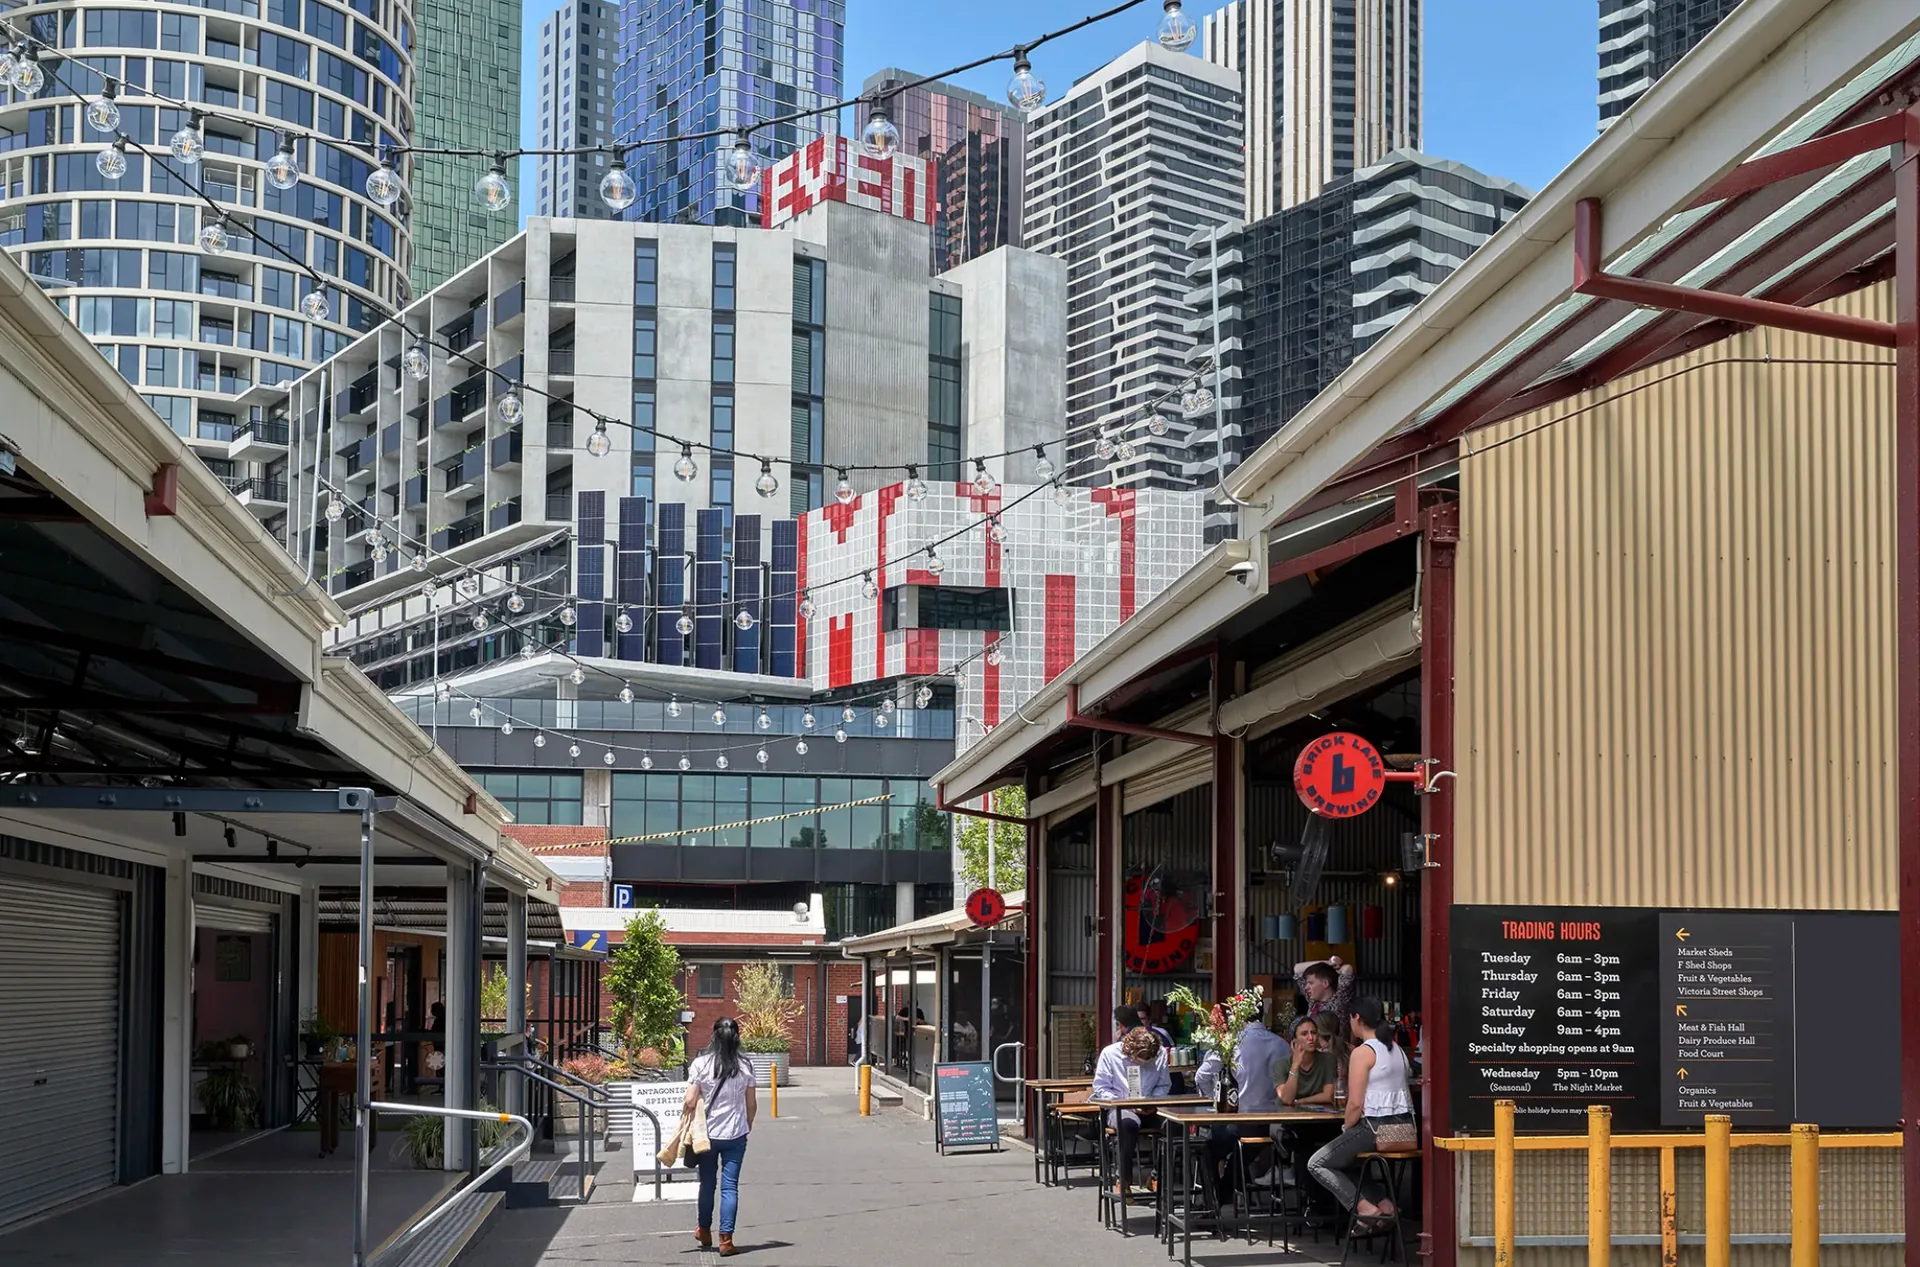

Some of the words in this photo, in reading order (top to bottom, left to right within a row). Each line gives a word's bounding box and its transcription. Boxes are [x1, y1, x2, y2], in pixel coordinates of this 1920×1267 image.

[1303, 736, 1345, 775] BRICK
[1352, 738, 1381, 779] LANE
[1332, 753, 1355, 794] b
[1306, 785, 1378, 814] BREWING
[619, 888, 630, 908] P
[1502, 921, 1554, 939] TRADING
[1561, 922, 1600, 940] HOURS
[1678, 948, 1707, 956] Market
[1482, 952, 1531, 965] Tuesday
[1557, 953, 1582, 964] 6am
[1594, 953, 1620, 966] 3pm
[1678, 961, 1684, 969] F
[1707, 962, 1732, 971] Shops
[1482, 970, 1538, 983] Thursday
[1557, 971, 1582, 982] 6am
[1594, 971, 1620, 983] 3pm
[1678, 974, 1697, 982] Fruit
[1708, 975, 1751, 984] Vegetables
[1482, 988, 1520, 1001] Friday
[1557, 989, 1582, 999] 6am
[1594, 989, 1620, 1001] 3pm
[1678, 987, 1710, 995] Victoria
[1739, 988, 1763, 997] Shops
[1482, 1006, 1535, 1019] Saturday
[1557, 1006, 1583, 1017] 6am
[1594, 1007, 1620, 1019] 4pm
[1482, 1024, 1525, 1037] Sunday
[1557, 1025, 1583, 1035] 9am
[1594, 1025, 1620, 1037] 4pm
[1679, 1036, 1701, 1046] Dairy
[1469, 1043, 1516, 1054] Specialty
[1519, 1043, 1565, 1054] shopping
[1568, 1045, 1597, 1054] opens
[1612, 1044, 1634, 1052] 9am
[1481, 1068, 1540, 1080] Wednesday
[1557, 1069, 1579, 1079] 5pm
[1590, 1069, 1618, 1079] 10pm
[637, 1087, 688, 1095] ANTAGONIS
[1490, 1083, 1531, 1092] (Seasonal)
[1553, 1083, 1568, 1091] The
[1570, 1084, 1592, 1092] Night
[1679, 1087, 1716, 1095] Organics
[1709, 1099, 1753, 1109] Vegetables
[1528, 1107, 1550, 1115] holiday
